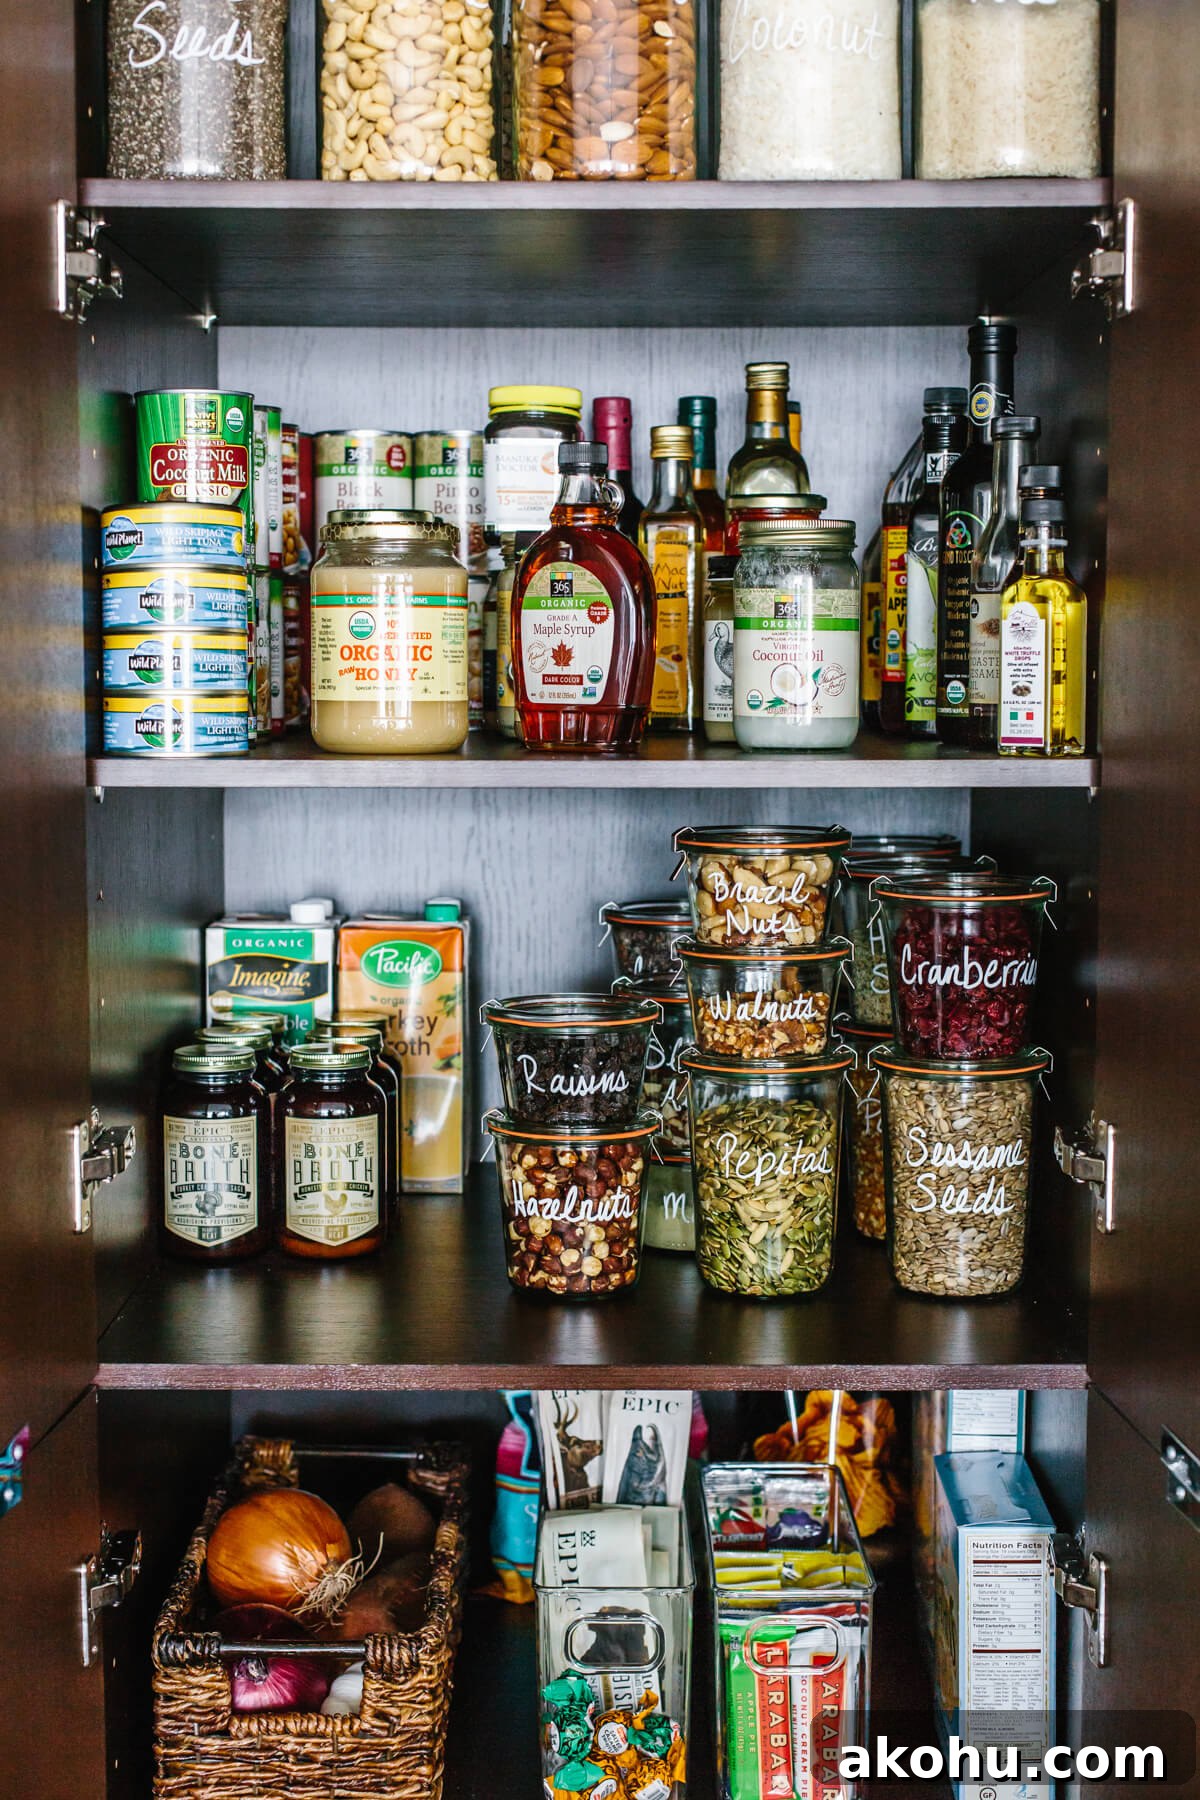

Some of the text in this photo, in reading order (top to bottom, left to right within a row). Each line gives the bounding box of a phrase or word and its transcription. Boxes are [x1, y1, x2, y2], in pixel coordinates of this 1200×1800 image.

[129, 1, 266, 68] Seeds
[191, 412, 216, 420] ATIVE
[168, 449, 234, 462] ORGANIC
[153, 459, 246, 483] Coconut Milk
[430, 467, 483, 475] ORGAIC
[174, 484, 229, 496] CLASSIC
[338, 482, 382, 496] Blak
[436, 483, 479, 497] Pino
[155, 528, 226, 538] WILD SKIPJACK
[196, 538, 221, 546] TUNA
[654, 563, 687, 576] Mac
[553, 582, 570, 593] 365
[657, 580, 685, 591] Nut
[142, 595, 162, 608] Wild
[541, 599, 586, 607] ORGANIC
[778, 604, 797, 615] 365
[533, 624, 595, 637] Maple Syrup
[130, 657, 149, 669] Wild
[338, 666, 355, 677] RAW
[137, 722, 158, 733] Wild
[207, 726, 232, 734] LIGHT
[708, 872, 810, 904] Brazil
[726, 908, 802, 936] Nuts
[232, 938, 305, 948] ORGANIC
[370, 947, 433, 978] Pacific
[901, 944, 1038, 989] Cranberrie
[228, 964, 307, 995] Imagine
[380, 997, 422, 1007] organic
[709, 990, 818, 1021] Walnuts
[517, 1054, 629, 1096] Raisins
[179, 1142, 239, 1158] BONE
[304, 1141, 363, 1158] BONE
[906, 1126, 1024, 1174] Sessame
[716, 1133, 833, 1186] Pepitas
[170, 1159, 250, 1184] BROTH
[294, 1157, 372, 1185] BROTH
[912, 1172, 1015, 1216] Seeds
[512, 1180, 634, 1224] Hazelnuts
[622, 1397, 680, 1415] EPIC
[822, 1682, 840, 1800] ÄRABAR
